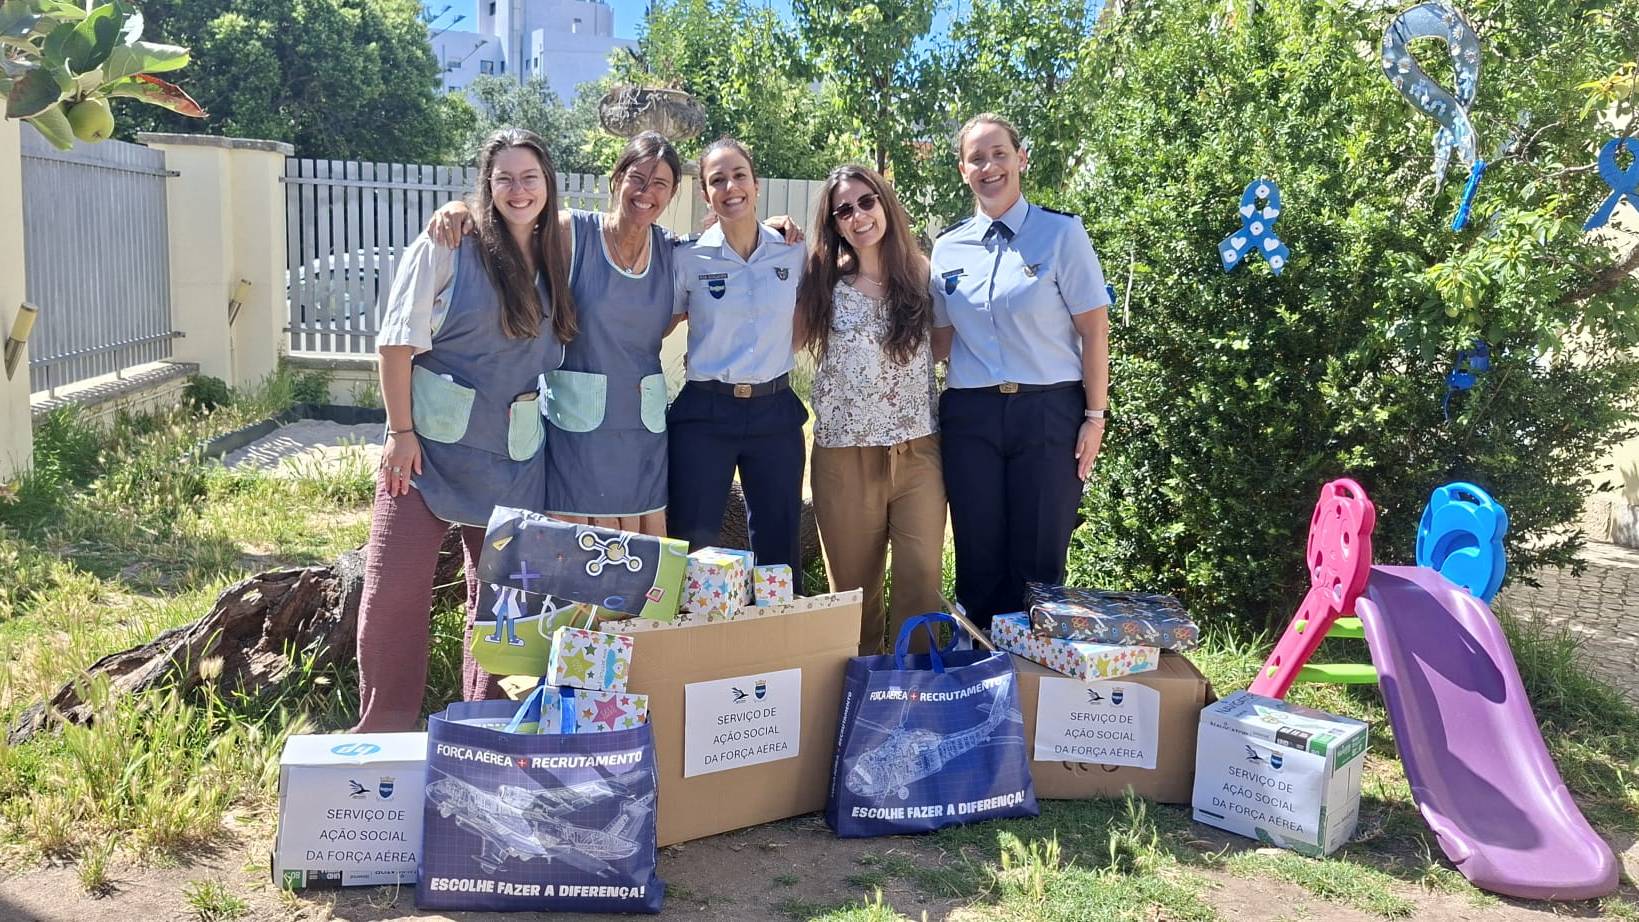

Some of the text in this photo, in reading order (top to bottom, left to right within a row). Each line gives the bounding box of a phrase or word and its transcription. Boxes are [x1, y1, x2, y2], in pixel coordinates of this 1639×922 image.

[919, 680, 1002, 702] RECRUTAMENTO
[717, 707, 777, 726] SERVIÇO DE
[1070, 711, 1134, 724] SERVIÇO DE
[713, 725, 780, 745] AÇÃO SOCIAL
[1064, 727, 1136, 742] AÇÃO SOCIAL
[436, 743, 643, 769] FORÇA AÉREA RECRUTAMENTO
[704, 754, 718, 765] DA
[720, 747, 755, 761] FORÇA
[1054, 744, 1144, 759] DA FORÇA AÉREA
[1228, 765, 1294, 794] SERVIÇO DE
[851, 790, 1025, 820] ESCOLHE FAZER A DIFERENÇA!
[1222, 782, 1296, 813] AÇÃO SOCIAL
[326, 808, 406, 822] SERVIÇO DE
[1212, 796, 1304, 833] DA FORÇA AÉREA
[319, 827, 408, 842] AÇÃO SOCIAL
[306, 850, 417, 863] DA FORÇA AÉREA
[430, 877, 646, 900] ESCOLHE FAZER A DIFERENÇA!
